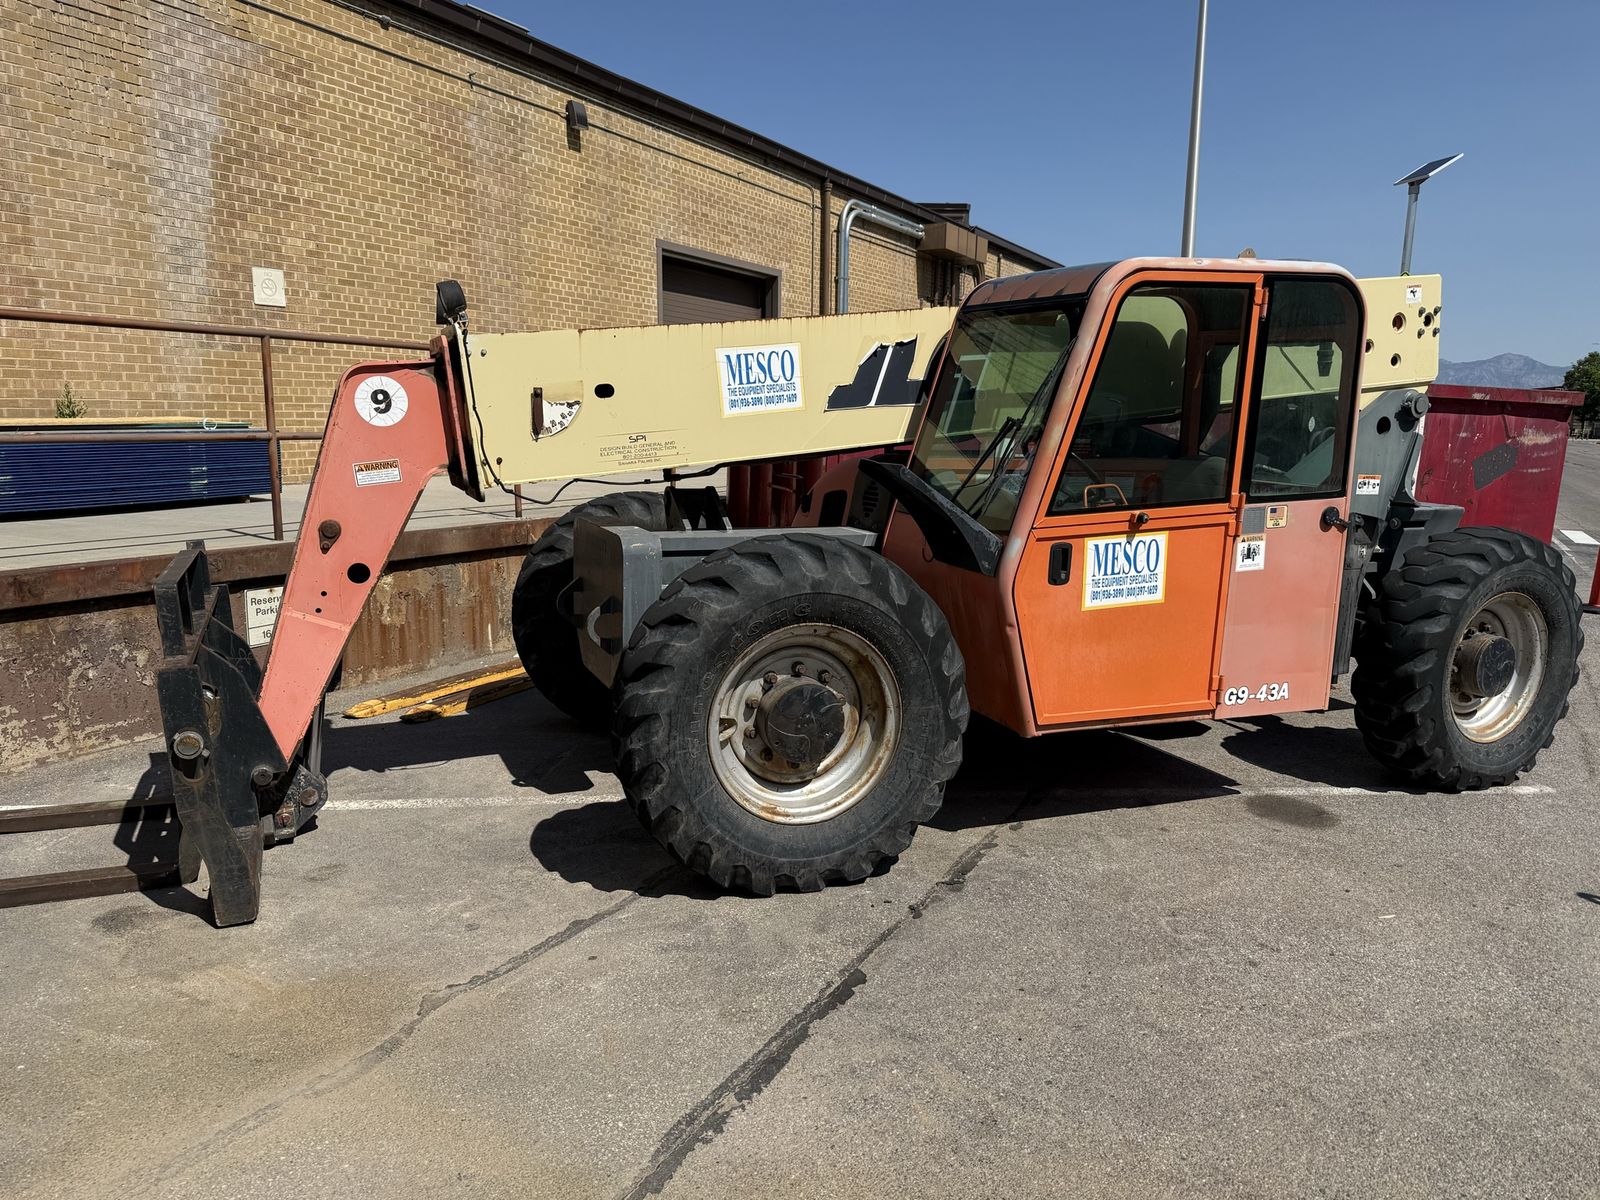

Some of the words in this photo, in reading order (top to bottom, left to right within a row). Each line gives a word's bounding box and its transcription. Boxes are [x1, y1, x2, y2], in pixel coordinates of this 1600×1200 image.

[725, 349, 795, 386] MESCO
[728, 387, 738, 397] THE
[738, 385, 765, 396] EQUIPMENT
[766, 382, 797, 394] SPECIALISTS
[370, 388, 392, 414] 9
[628, 434, 647, 443] SPI
[634, 445, 677, 454] CONSTRUCTION
[363, 461, 398, 471] WARNING
[1092, 538, 1160, 577] MESCO
[1091, 578, 1101, 589] THE
[1101, 576, 1128, 588] EQUIPMENT
[1129, 573, 1159, 585] SPECIALISTS
[1224, 681, 1290, 706] G9-43A
